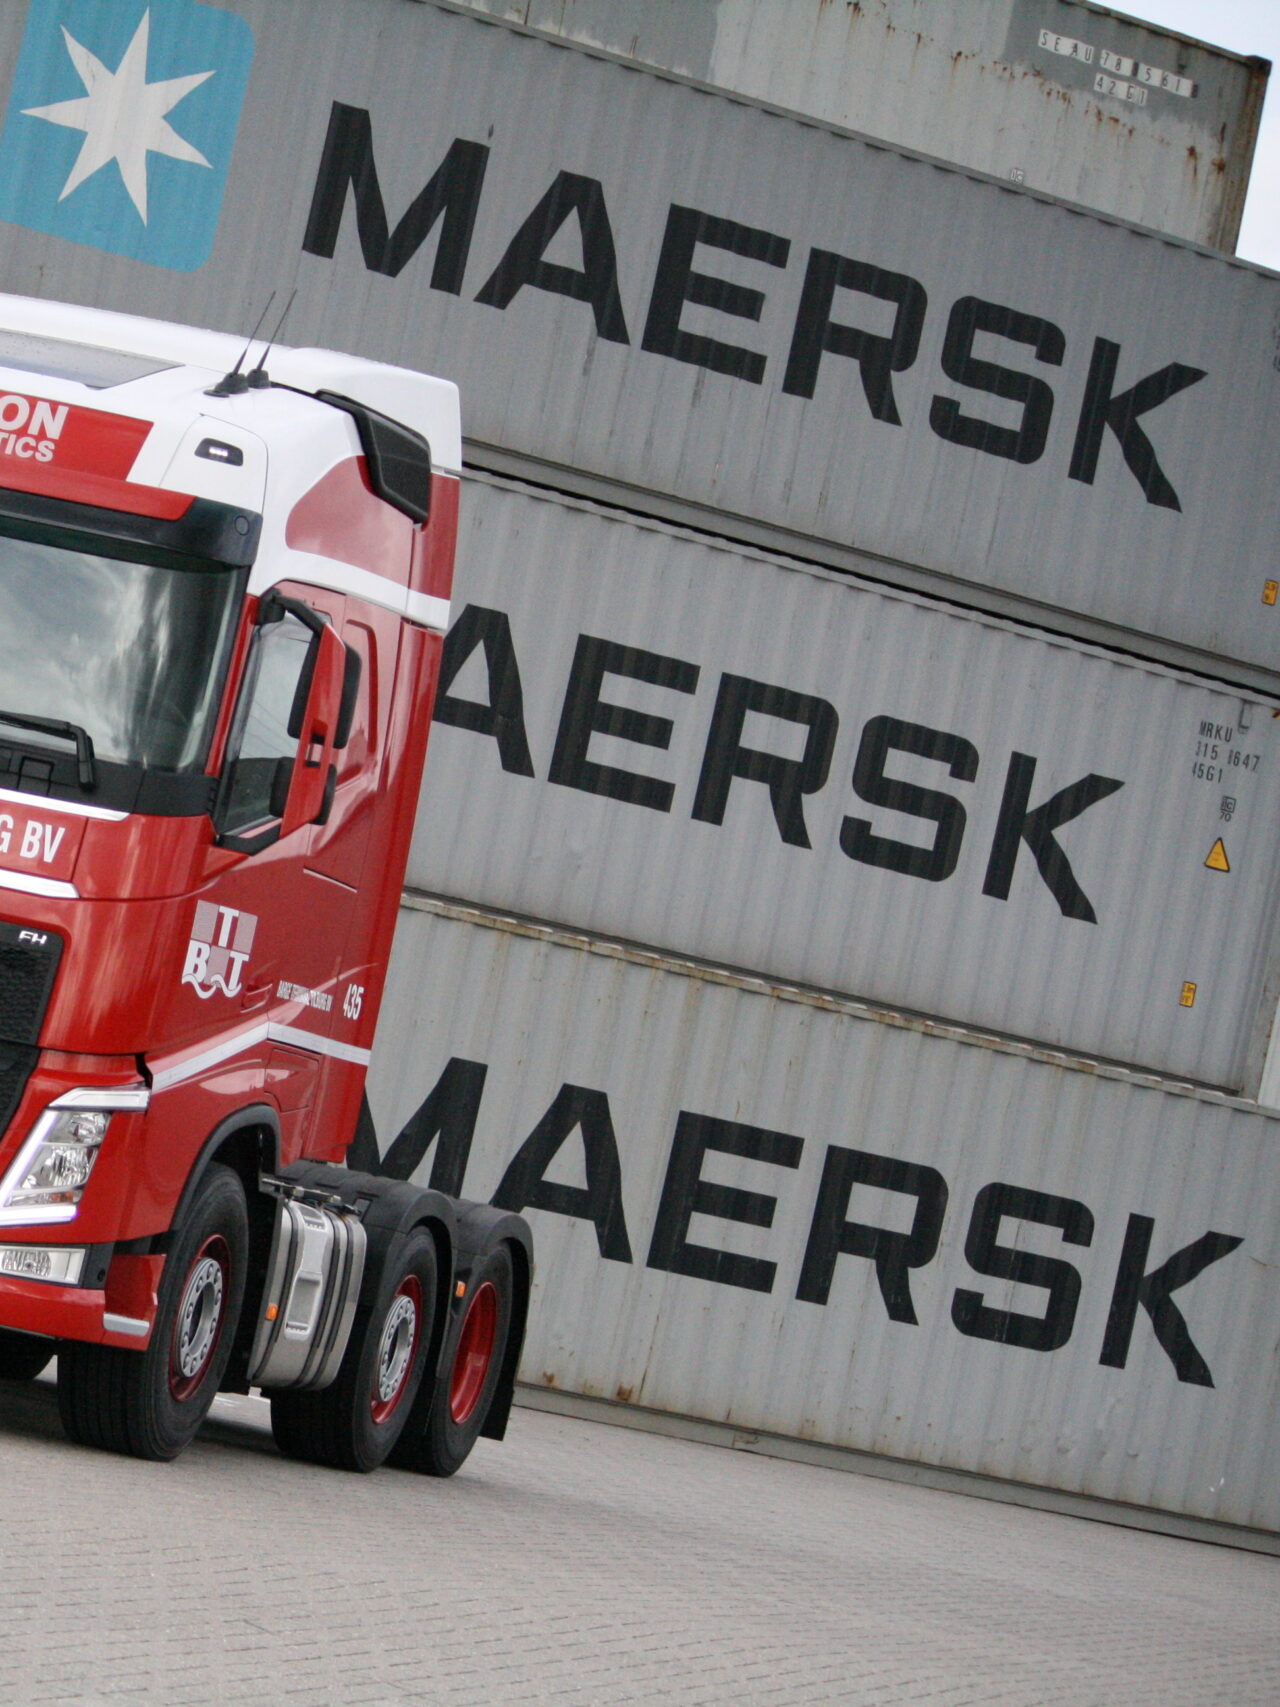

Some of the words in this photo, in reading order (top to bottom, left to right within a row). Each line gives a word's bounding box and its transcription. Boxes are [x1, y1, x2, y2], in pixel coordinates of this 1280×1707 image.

[1040, 31, 1093, 63] SEAU
[303, 101, 1207, 513] MAERSK
[1200, 720, 1234, 743] MRKU
[20, 821, 66, 863] BV
[18, 930, 48, 945] FH
[342, 983, 365, 1021] 435
